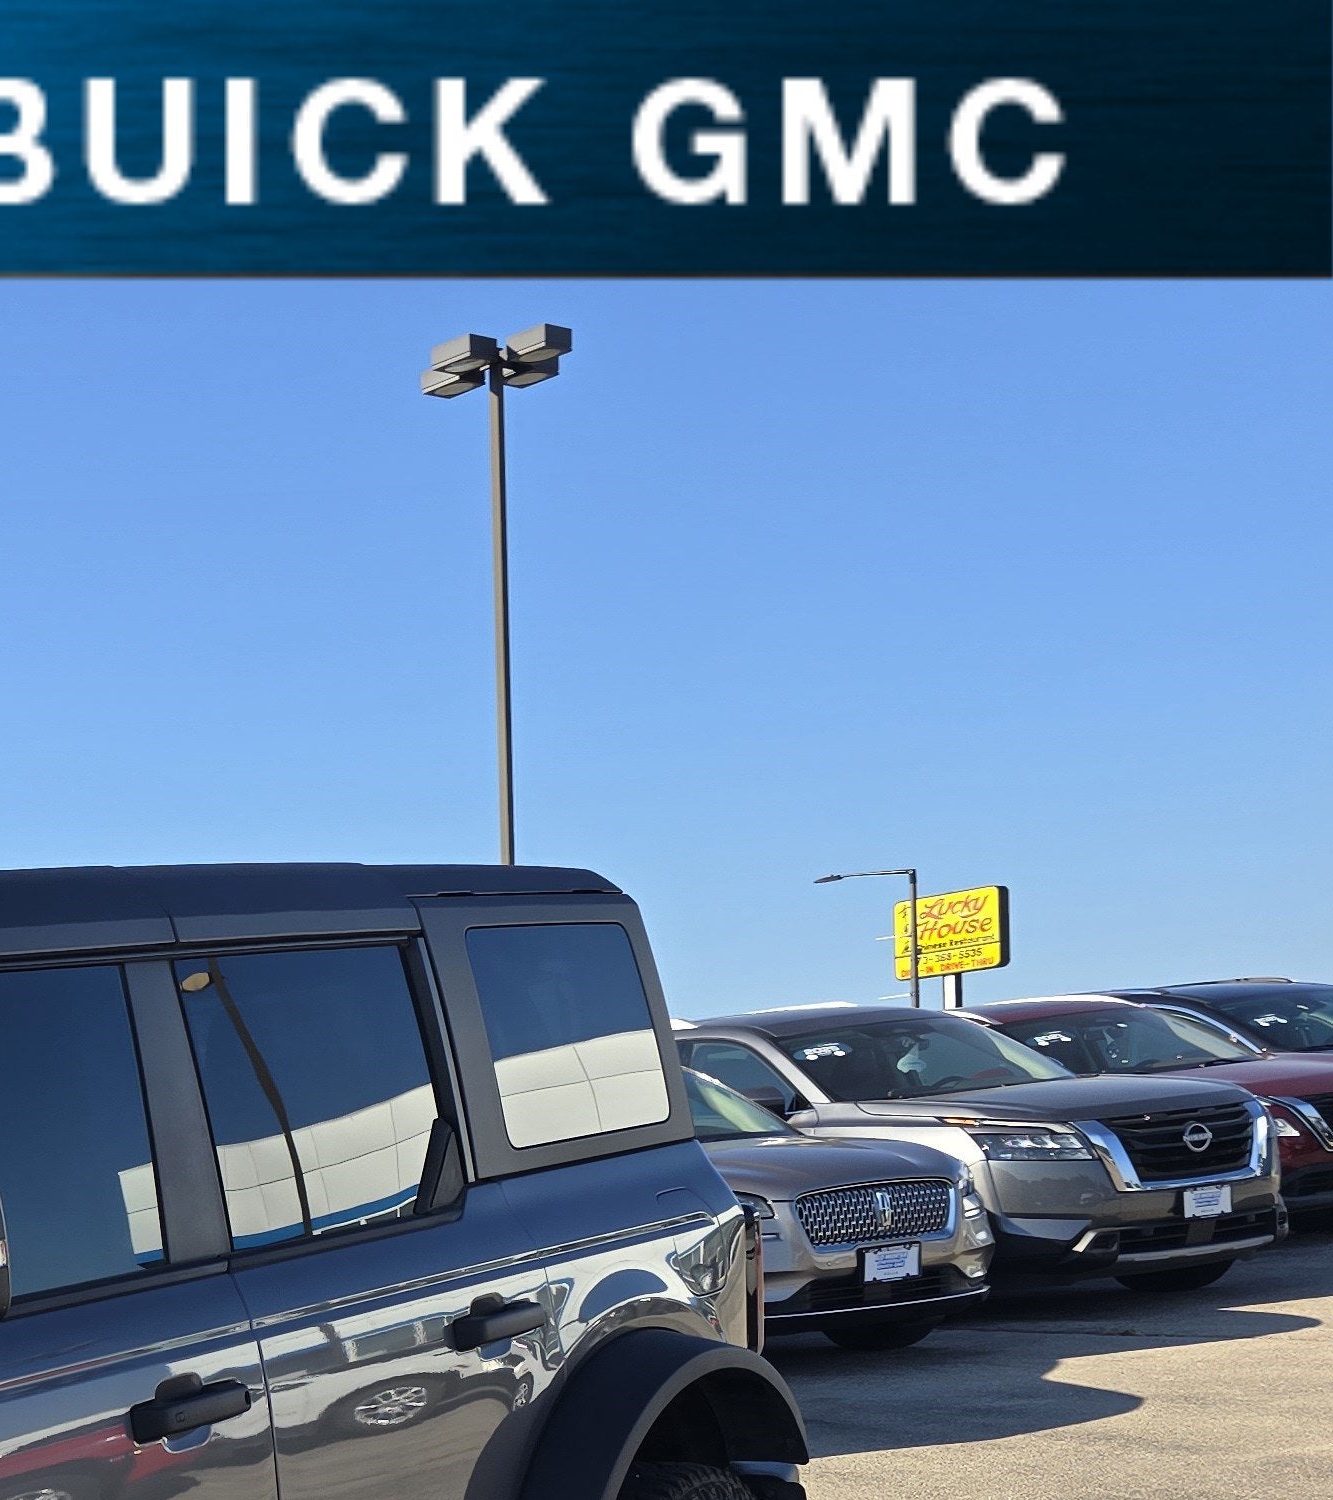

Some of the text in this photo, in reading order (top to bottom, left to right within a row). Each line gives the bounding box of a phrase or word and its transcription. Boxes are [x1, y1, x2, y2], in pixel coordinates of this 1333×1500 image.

[919, 895, 989, 919] Lucky
[917, 917, 993, 940] House
[917, 942, 946, 953] hinese
